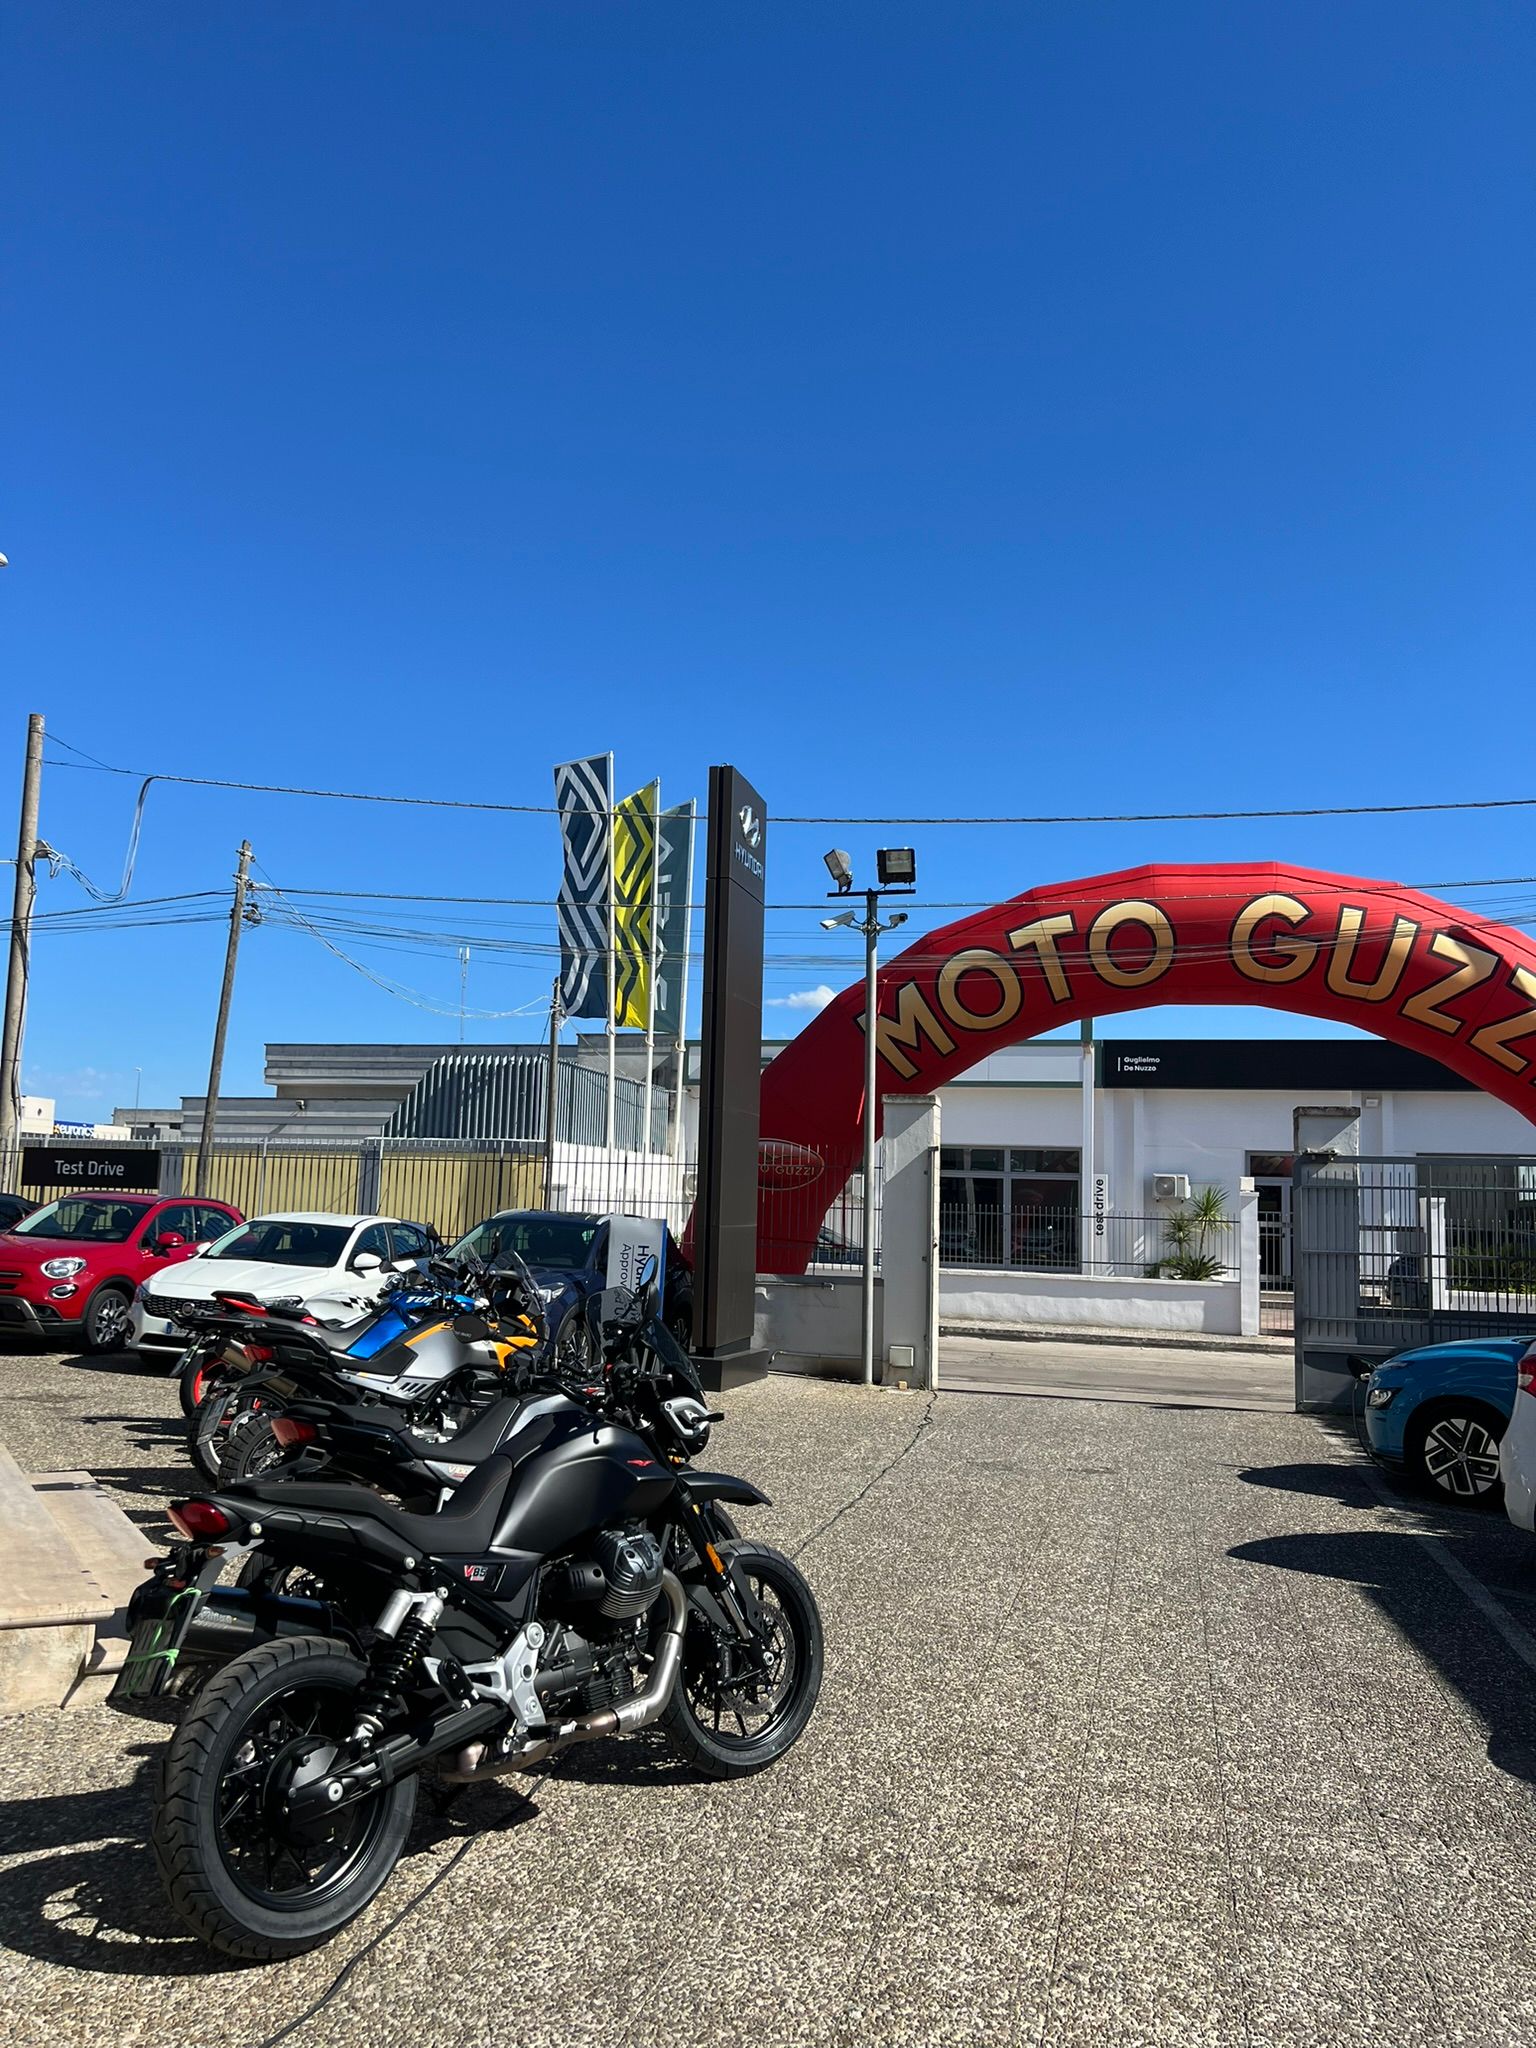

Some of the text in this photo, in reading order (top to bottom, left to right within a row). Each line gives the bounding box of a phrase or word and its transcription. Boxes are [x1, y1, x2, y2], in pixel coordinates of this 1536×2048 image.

[735, 841, 764, 880] HYUNDAI
[855, 892, 1536, 1088] MOTO GUZZ
[1123, 1056, 1161, 1064] Guglielmo
[54, 1160, 125, 1176] Test Drive
[1094, 1179, 1104, 1236] test drive
[464, 1565, 488, 1578] V85
